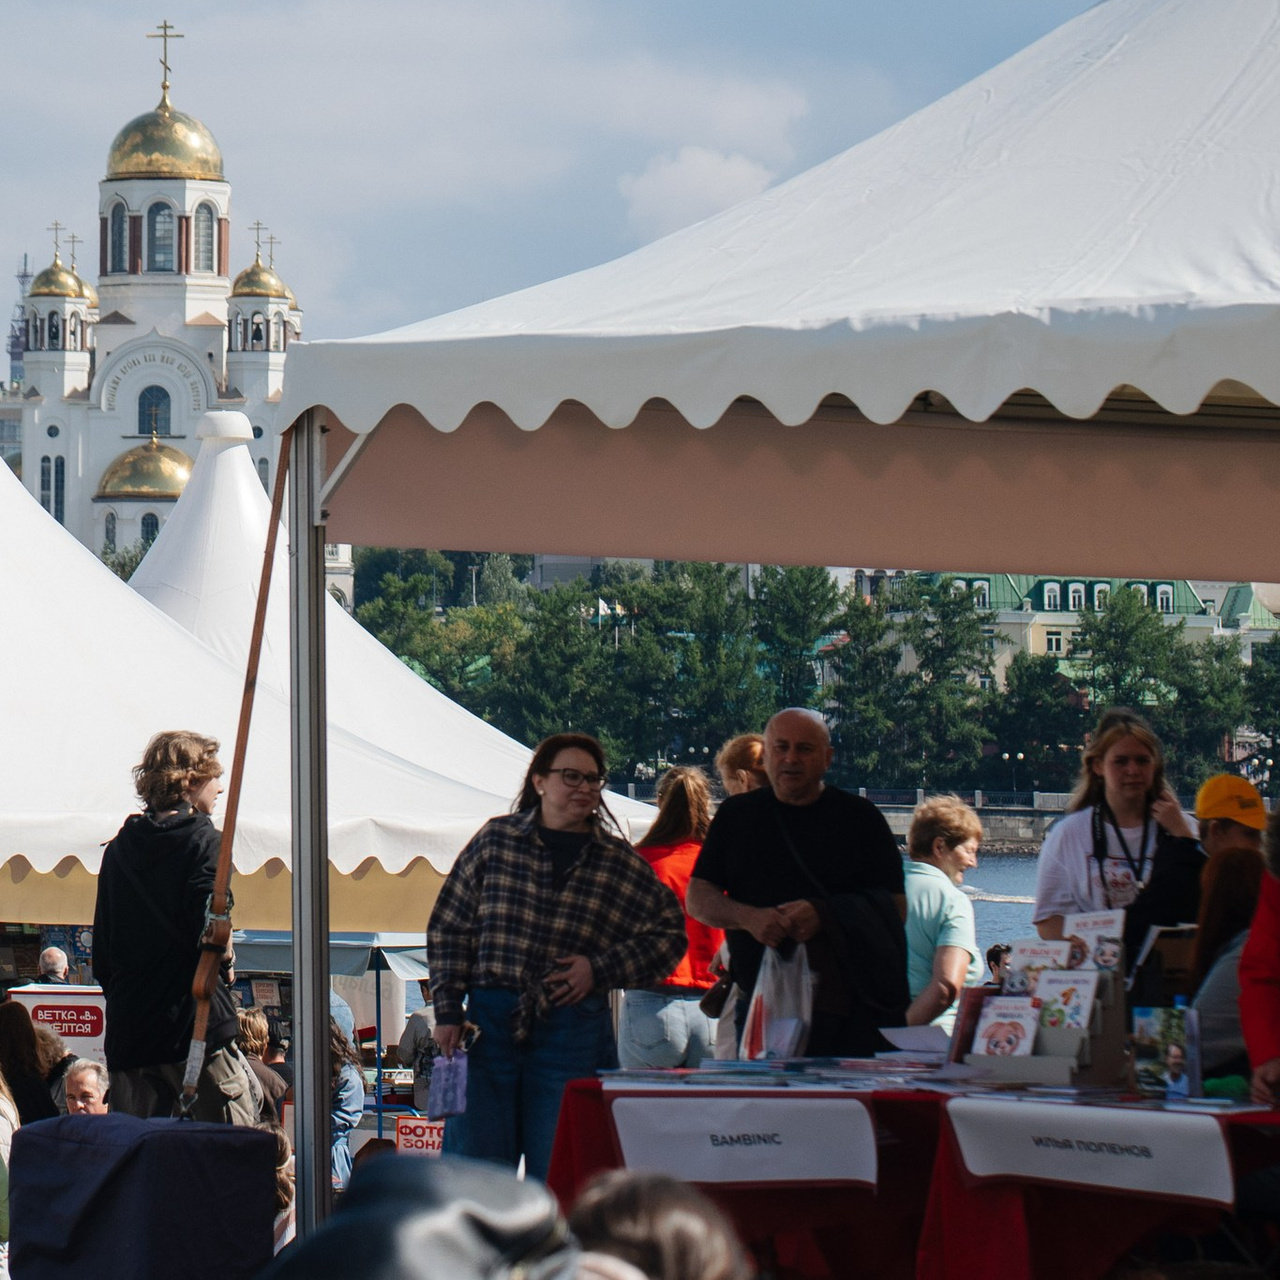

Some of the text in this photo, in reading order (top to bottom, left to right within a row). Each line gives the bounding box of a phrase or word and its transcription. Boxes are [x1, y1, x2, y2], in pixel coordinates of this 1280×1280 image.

[37, 1010, 98, 1021] ВЕТКА «В»
[399, 1125, 445, 1139] ФОТО
[709, 1132, 782, 1147] BAMBINIC
[1032, 1135, 1074, 1150] ИЛЬЯ
